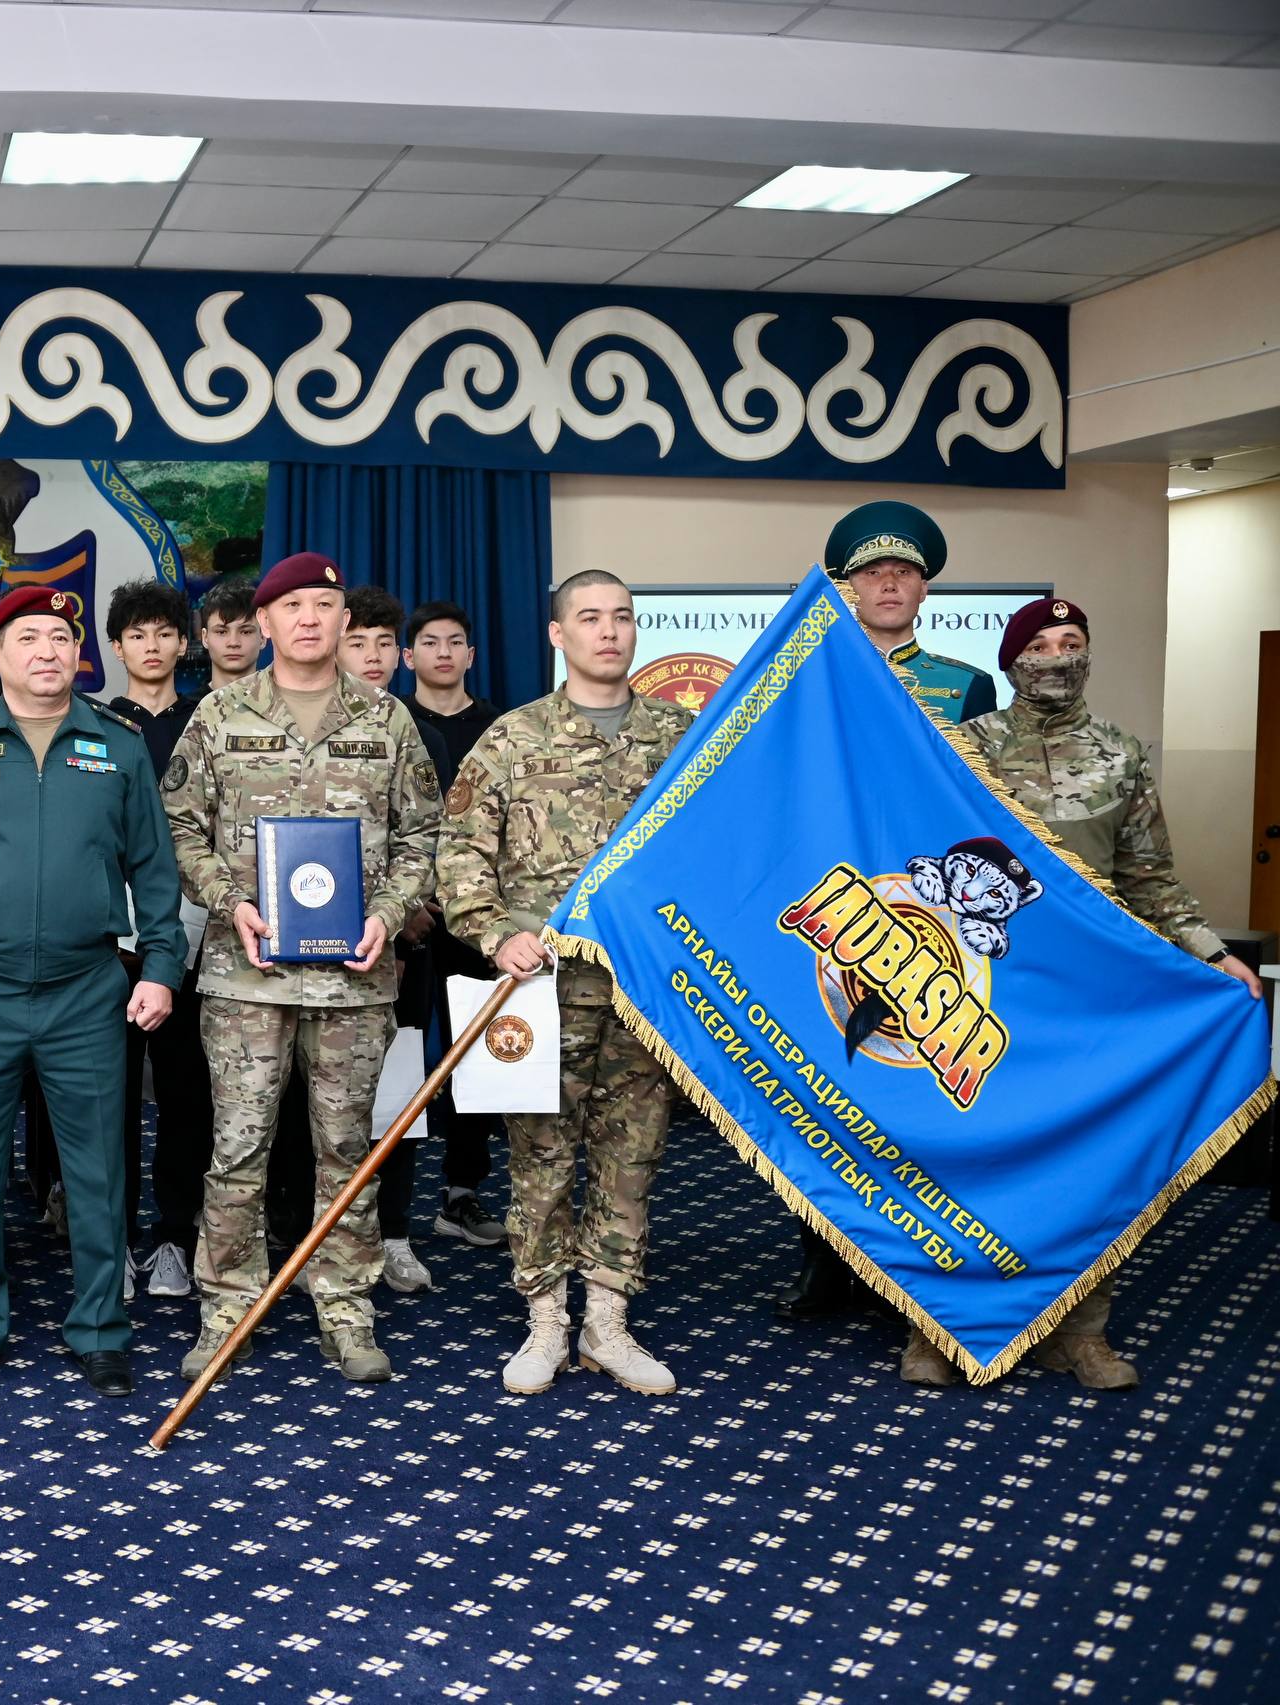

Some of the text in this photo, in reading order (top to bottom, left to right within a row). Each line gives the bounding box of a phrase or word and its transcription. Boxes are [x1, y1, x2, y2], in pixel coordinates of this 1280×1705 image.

[930, 612, 1014, 630] РӘСІМ
[657, 902, 748, 1005] АРНАЙЫ
[747, 1003, 901, 1161] ОПЕРАЦИЯЛАР
[780, 866, 1007, 1108] JAUBASAR
[671, 969, 964, 1273] ӘСКЕРИ-ПАТРИОТТЫҚ КЛУБЫ
